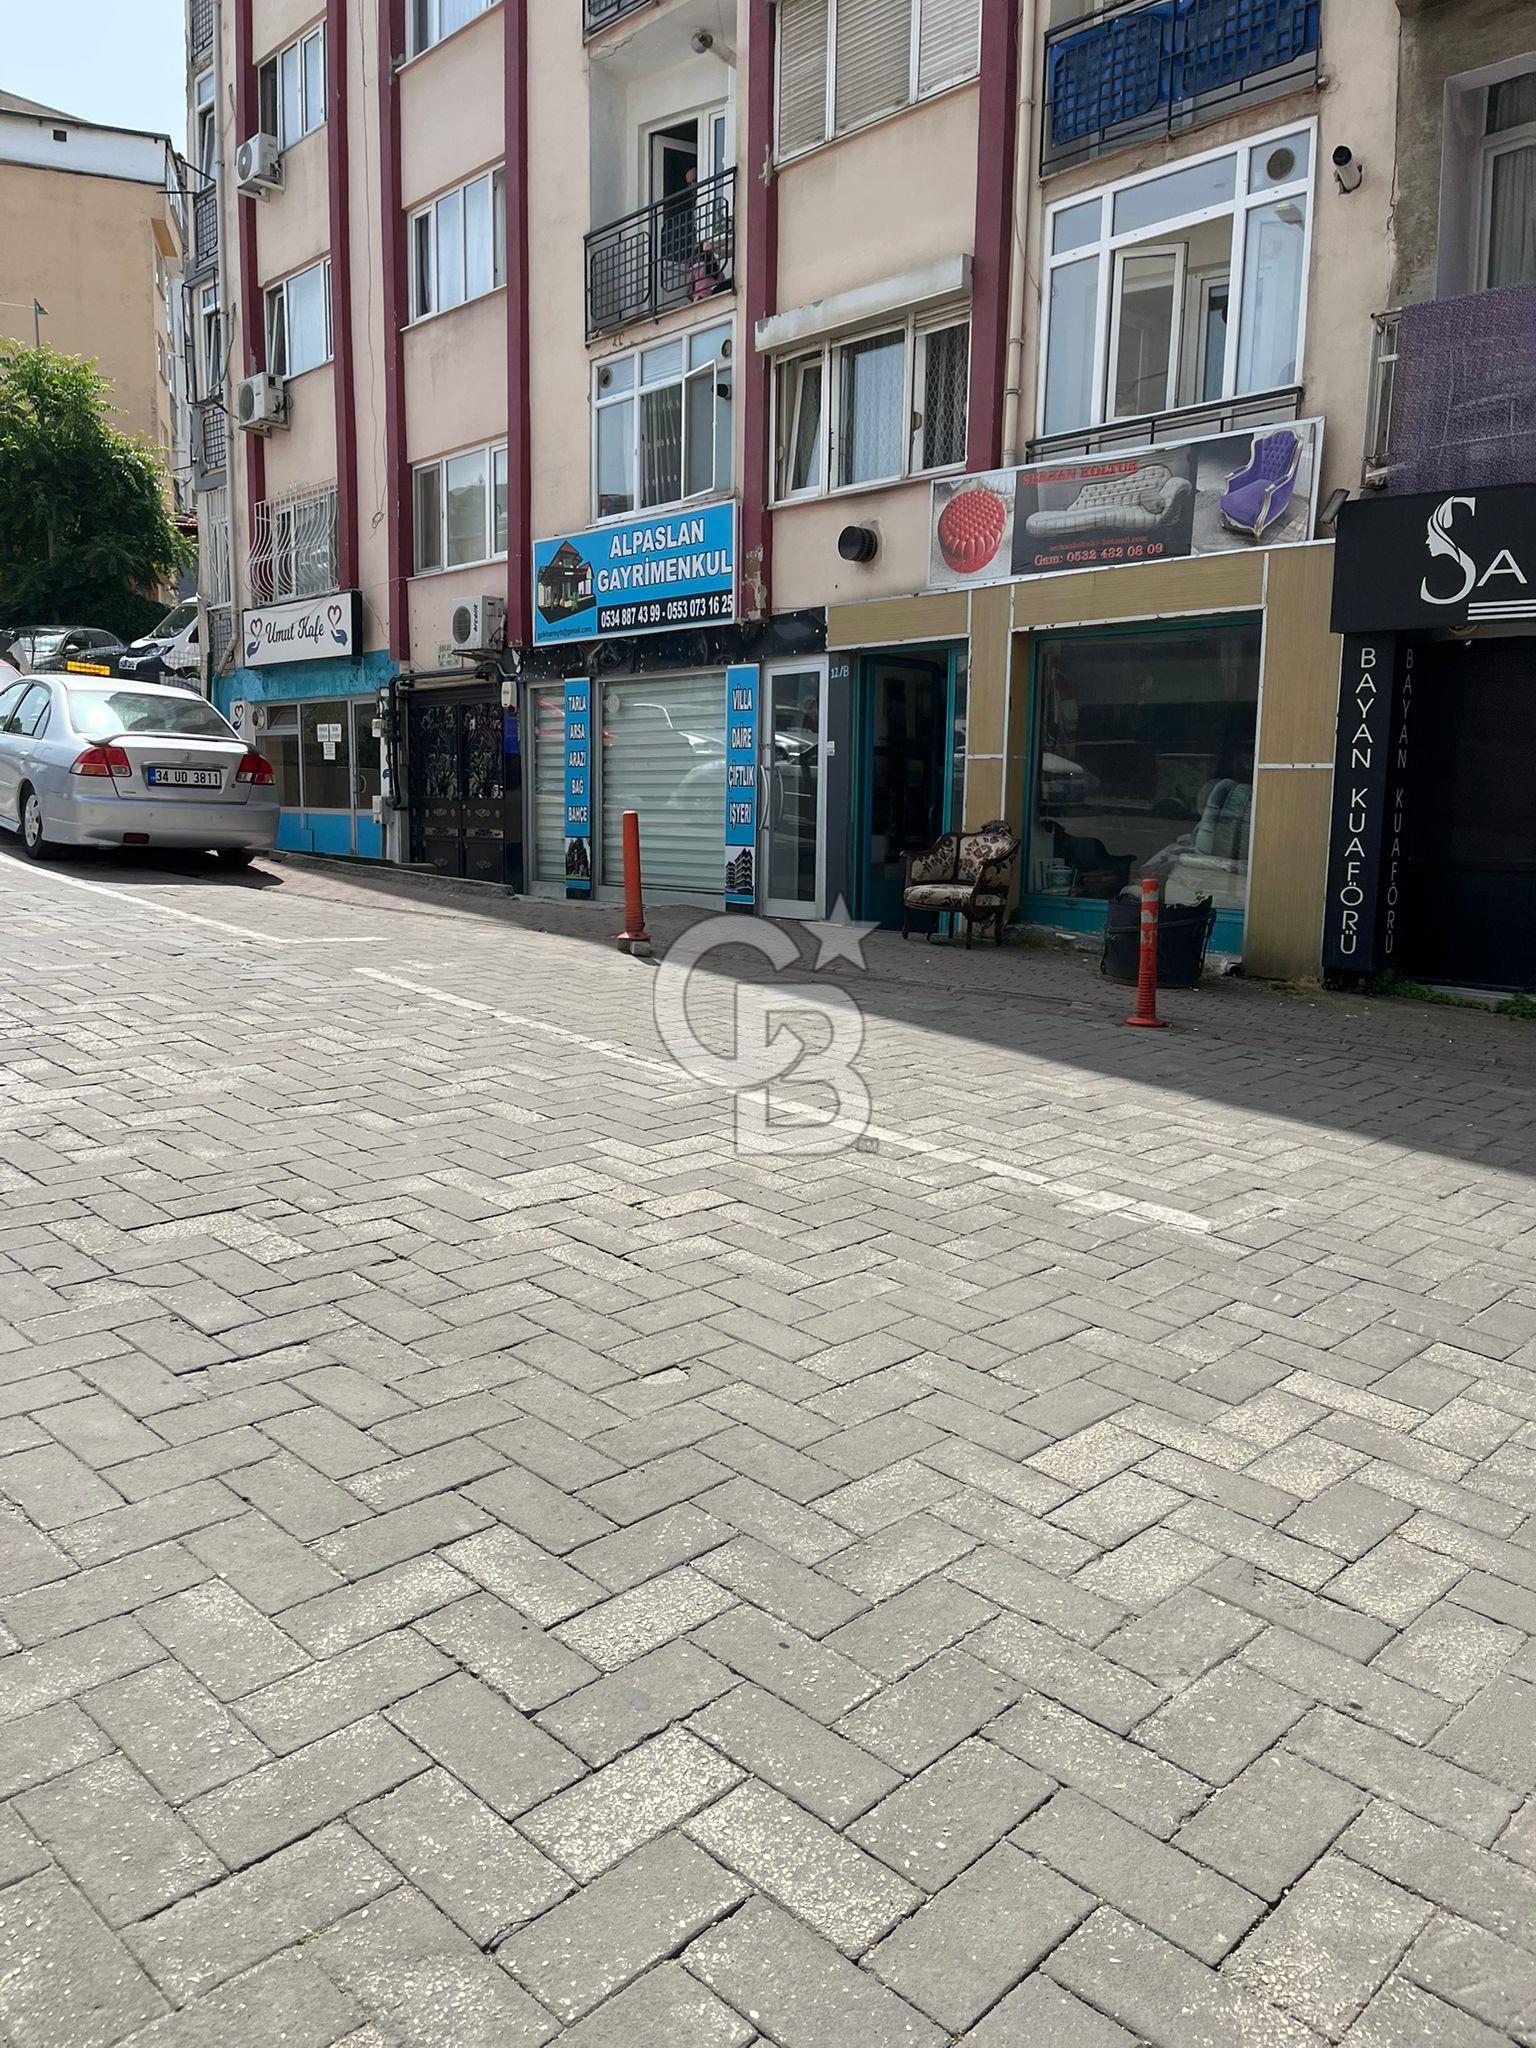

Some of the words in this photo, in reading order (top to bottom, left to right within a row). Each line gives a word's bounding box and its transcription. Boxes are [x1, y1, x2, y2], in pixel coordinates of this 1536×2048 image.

[609, 518, 705, 559] ALPASLAN
[597, 549, 733, 592] GAYRİMENKUL
[1034, 554, 1063, 566] Gsm:
[1066, 550, 1097, 562] 0532
[601, 609, 620, 628] 0534
[621, 607, 636, 626] 887
[638, 605, 649, 624] 43
[650, 604, 661, 621] 99
[667, 600, 688, 620] 0553
[690, 597, 706, 617] 073
[708, 596, 720, 615] 16
[721, 594, 733, 613] 25
[265, 621, 295, 643] Umut
[297, 614, 325, 644] Kafe
[568, 695, 587, 712] TARLA
[732, 684, 752, 712] VİLLA
[1351, 647, 1376, 769] BAYAN
[1397, 648, 1414, 769] BAYAN
[569, 723, 586, 740] ARSA
[731, 721, 752, 749] DAİRE
[568, 746, 587, 767] ARAZİ
[155, 770, 169, 783] 34
[174, 770, 188, 783] UD
[193, 771, 219, 785] 3811
[571, 775, 584, 795] BAĞ
[728, 761, 755, 791] ÇİFTLİK
[567, 805, 588, 826] BAHÇE
[729, 798, 752, 828] İŞYERİ
[1340, 787, 1369, 955] KUAFÖRÜ
